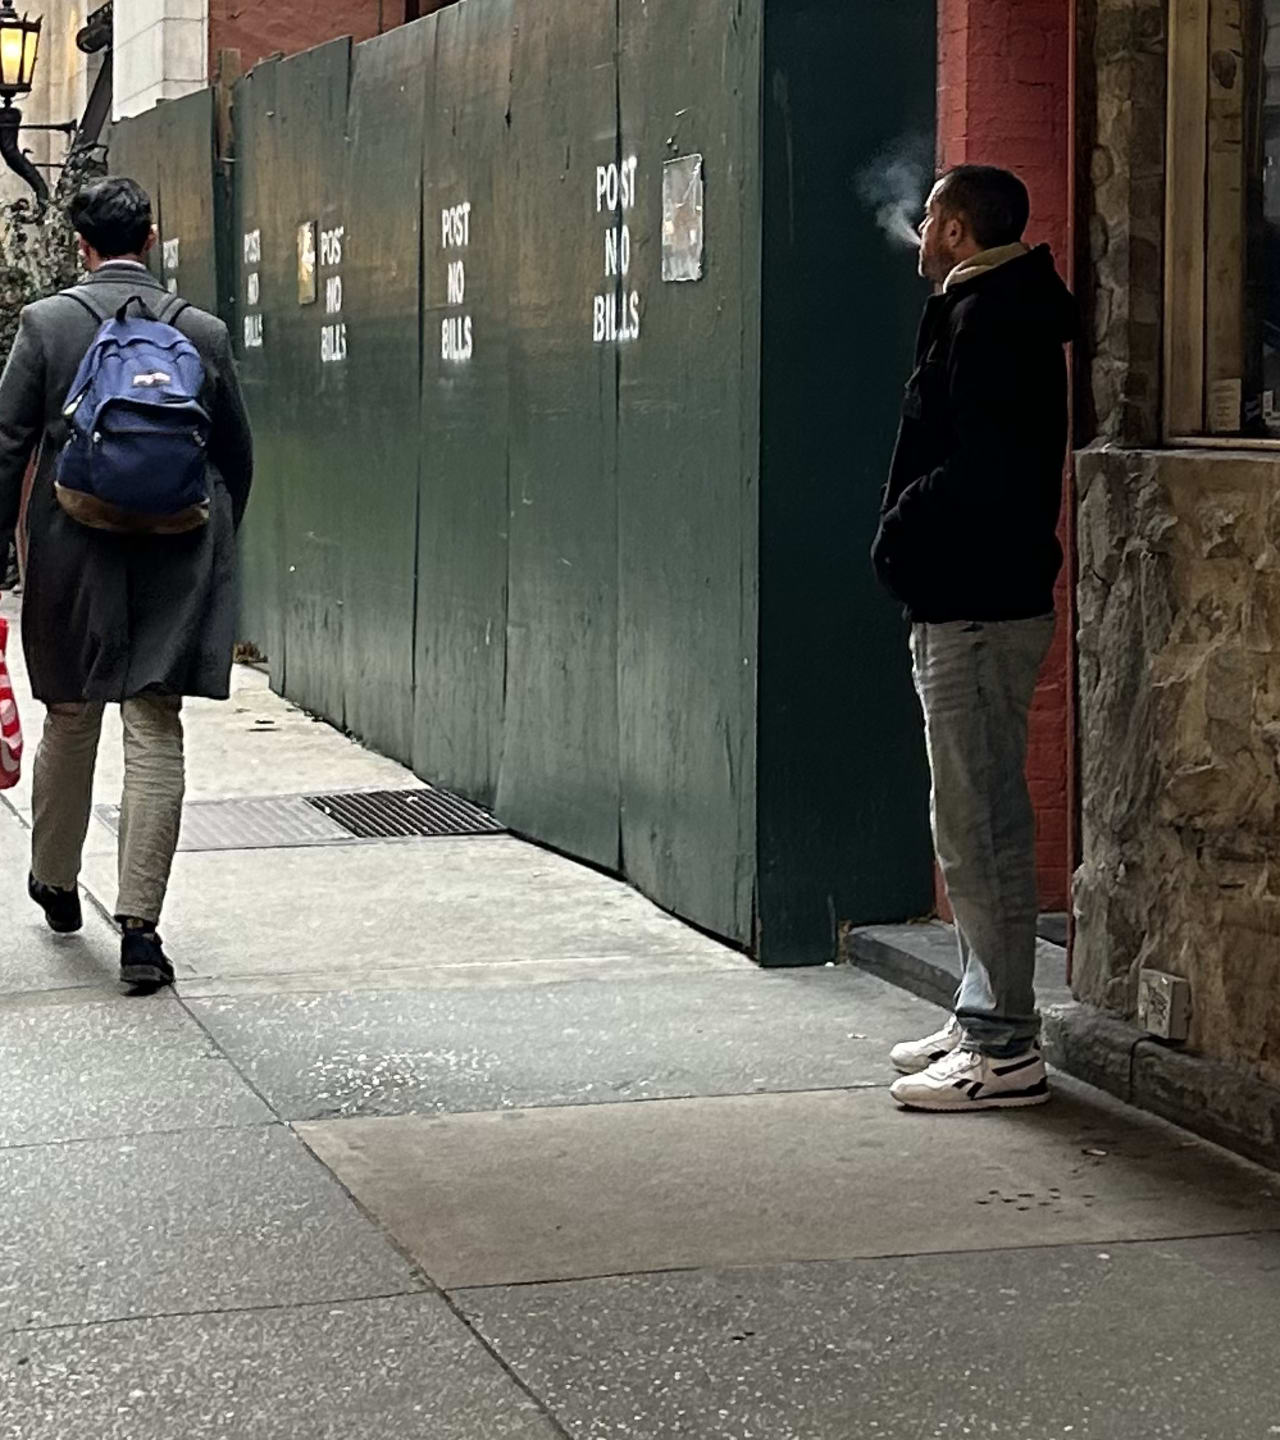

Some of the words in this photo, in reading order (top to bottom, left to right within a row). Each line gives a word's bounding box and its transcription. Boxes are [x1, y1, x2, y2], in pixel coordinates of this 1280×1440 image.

[596, 155, 637, 212] POST
[442, 201, 470, 249] POST
[605, 225, 630, 277] NO
[326, 275, 343, 314] NO
[447, 260, 465, 305] NO
[441, 315, 472, 361] BILLS
[593, 291, 640, 343] BILLS
